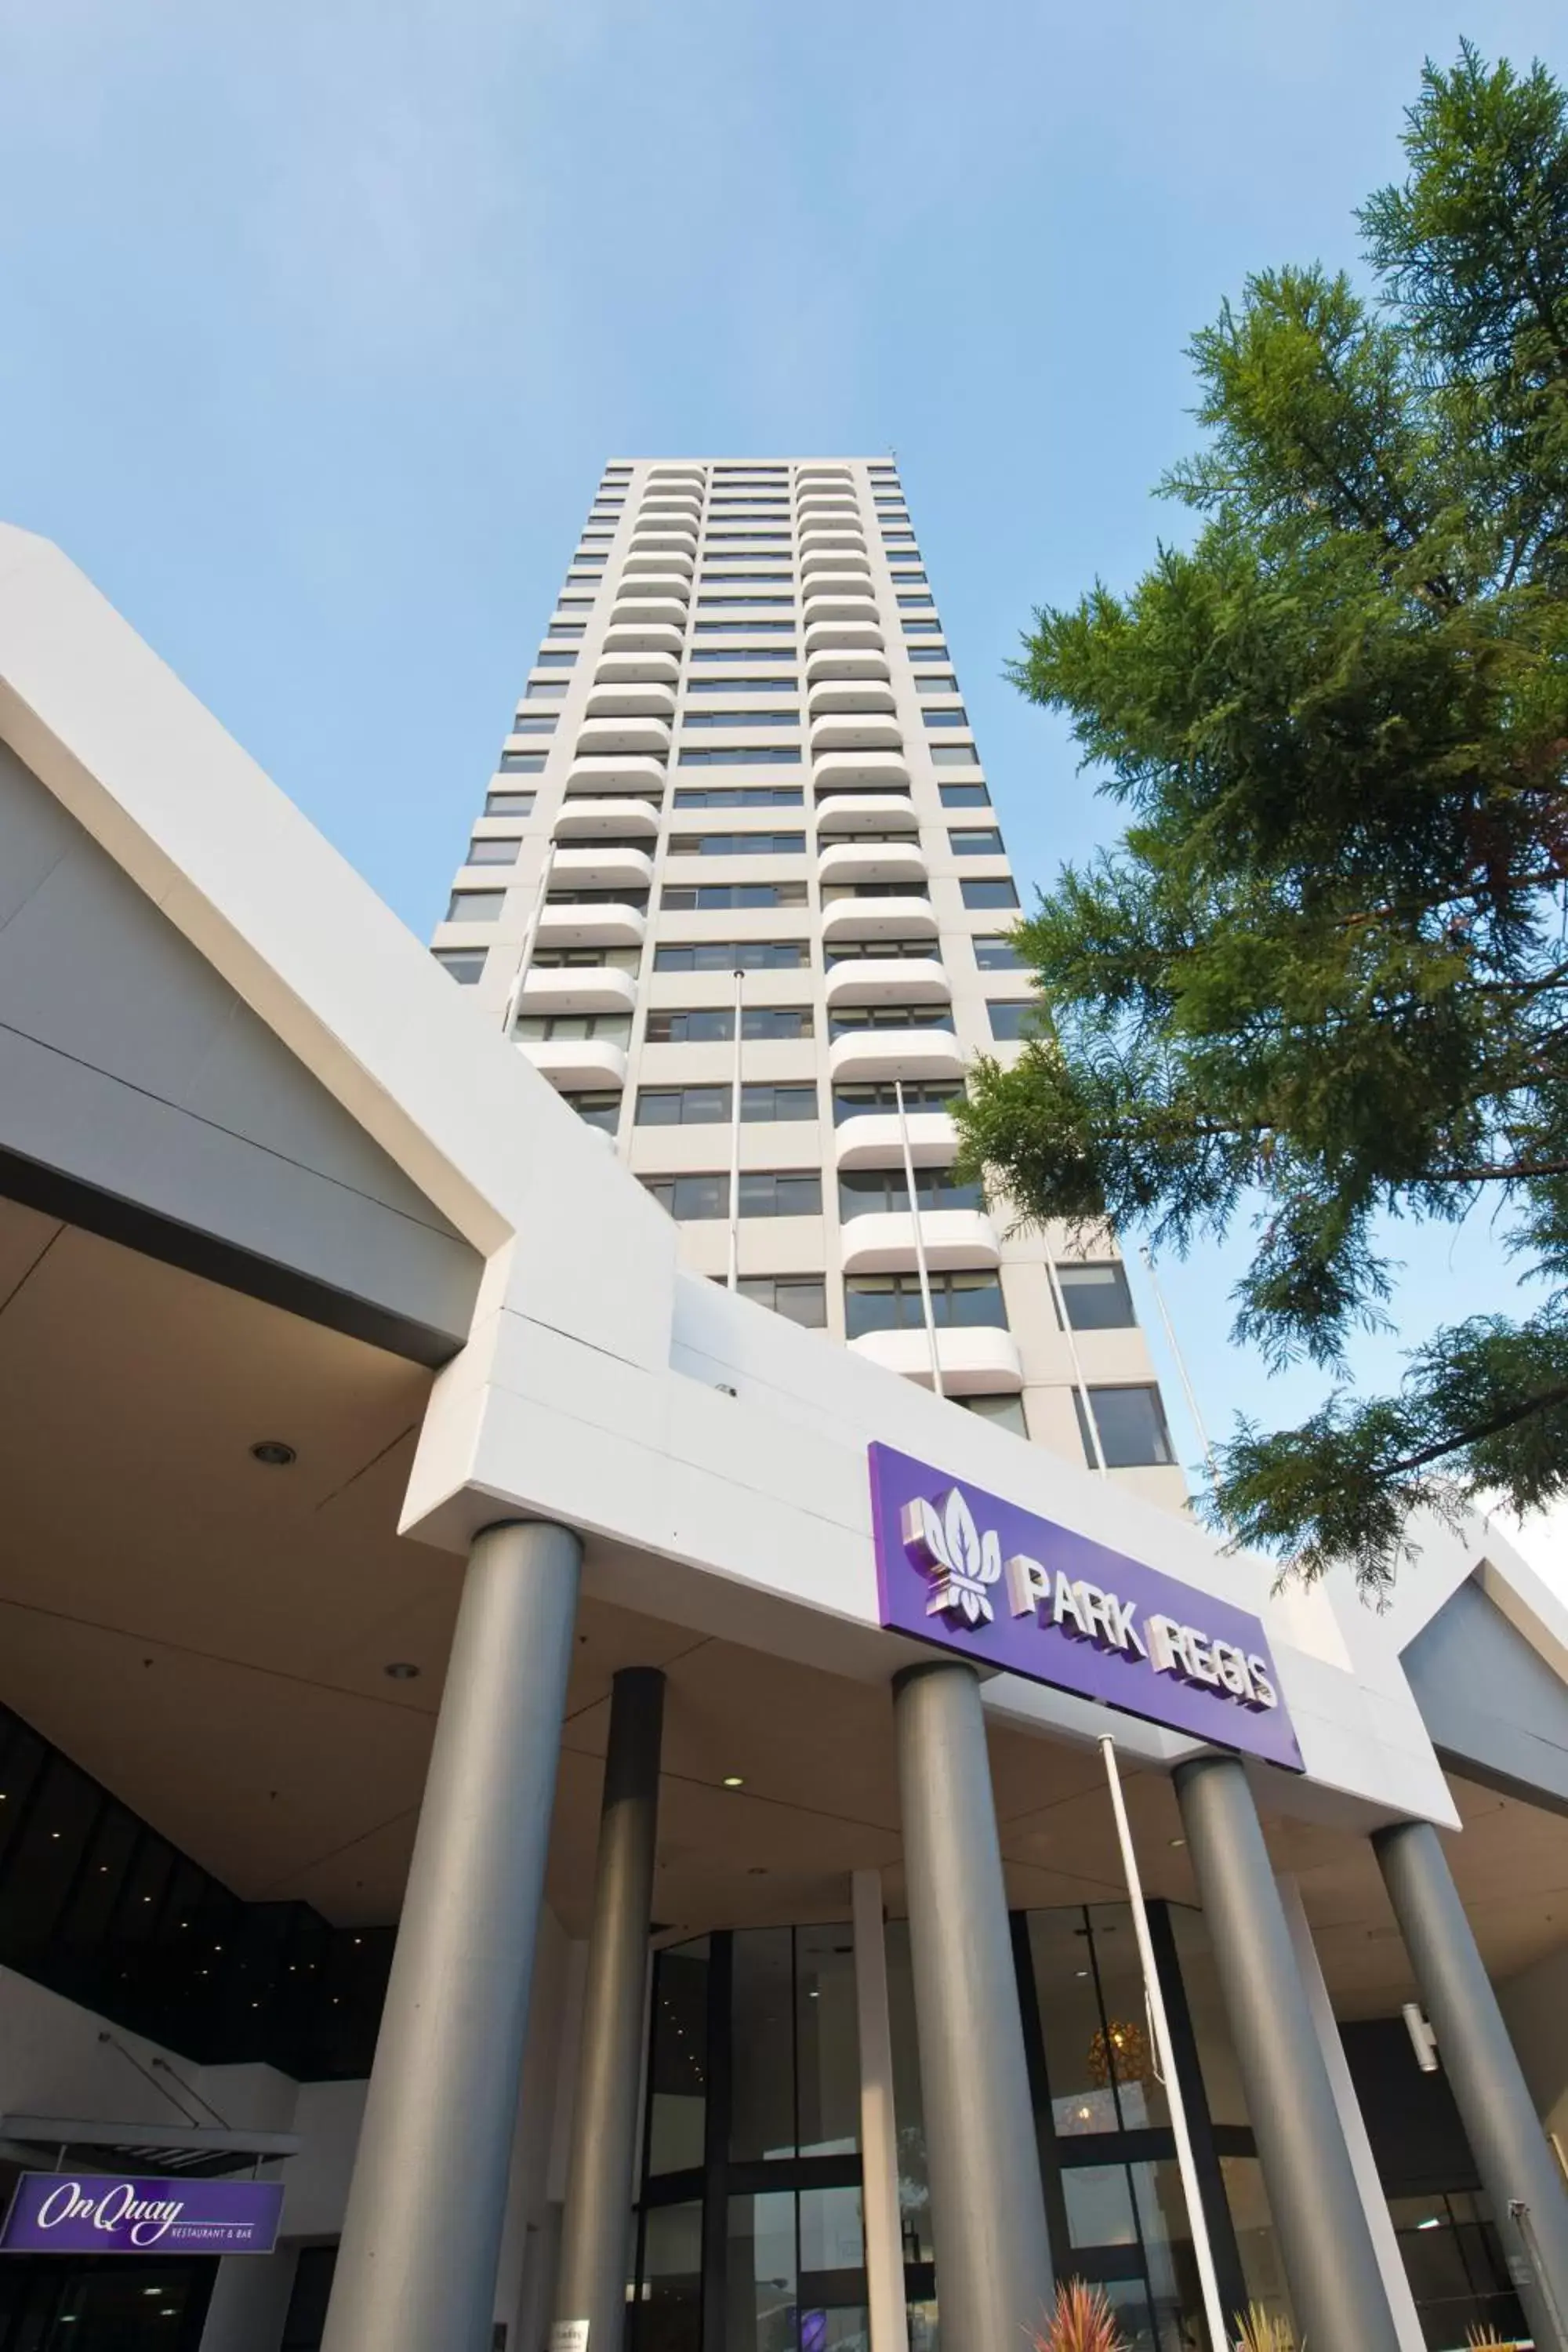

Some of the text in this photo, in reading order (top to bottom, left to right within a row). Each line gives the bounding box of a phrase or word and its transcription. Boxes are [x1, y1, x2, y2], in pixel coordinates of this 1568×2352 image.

[1005, 1554, 1277, 1709] PARK REGIS
[172, 2227, 225, 2239] RESTAURANT
[236, 2229, 252, 2239] BAR
